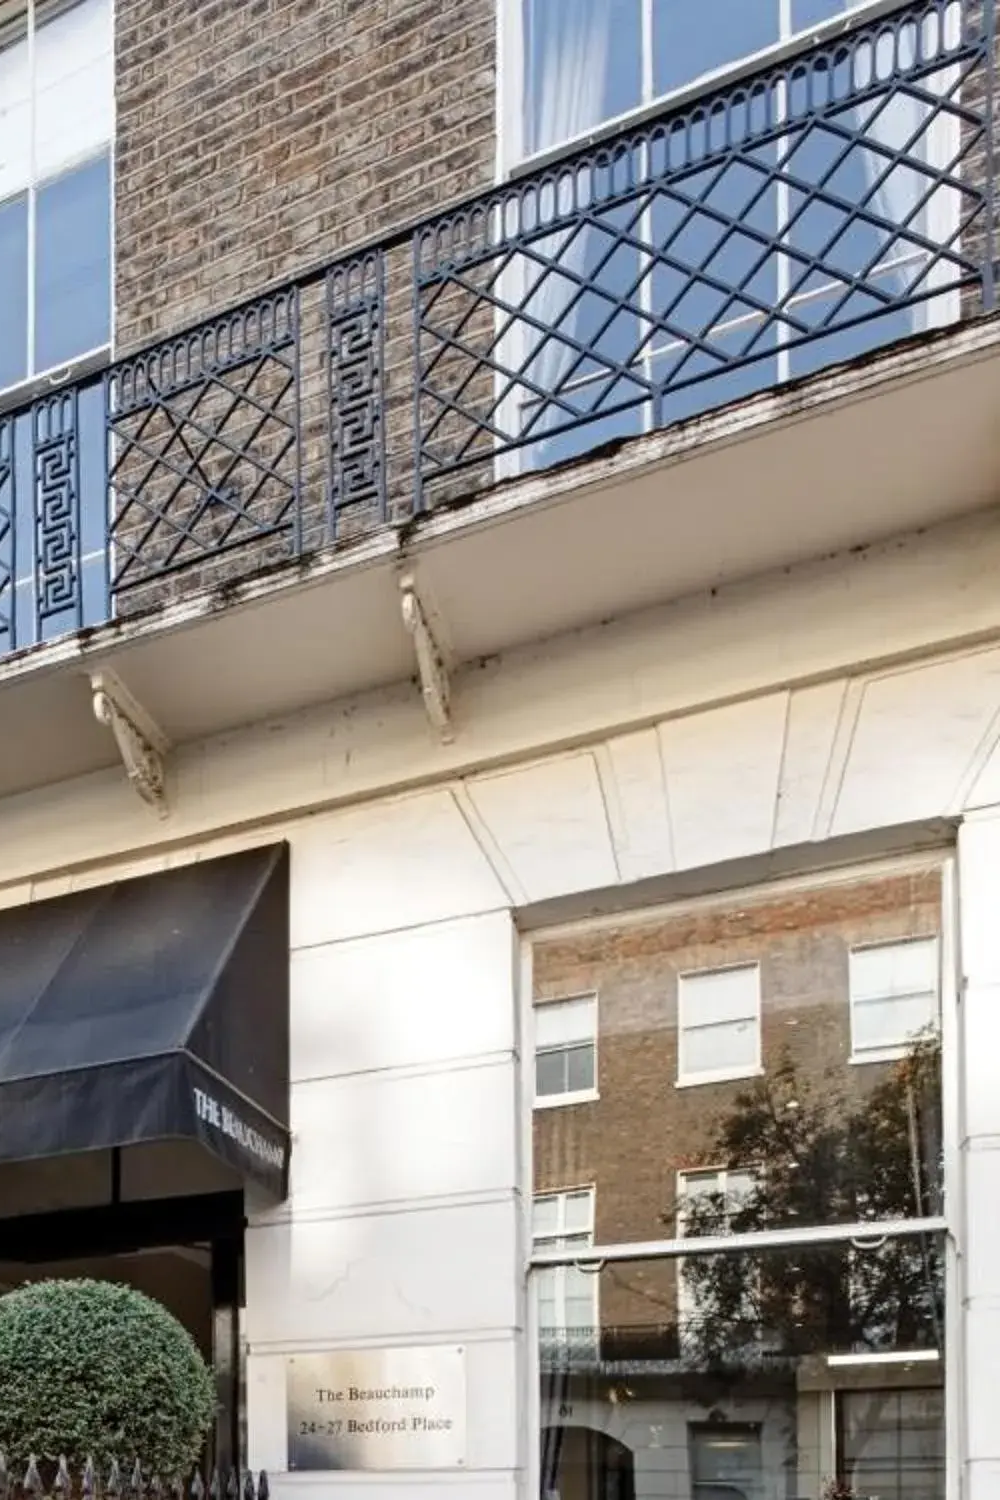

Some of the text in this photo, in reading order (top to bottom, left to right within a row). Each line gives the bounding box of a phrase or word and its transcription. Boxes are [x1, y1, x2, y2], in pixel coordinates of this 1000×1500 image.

[193, 1087, 221, 1128] THE
[316, 1385, 436, 1402] The Beauchamp
[299, 1415, 453, 1435] 24-27 Bedford Place
